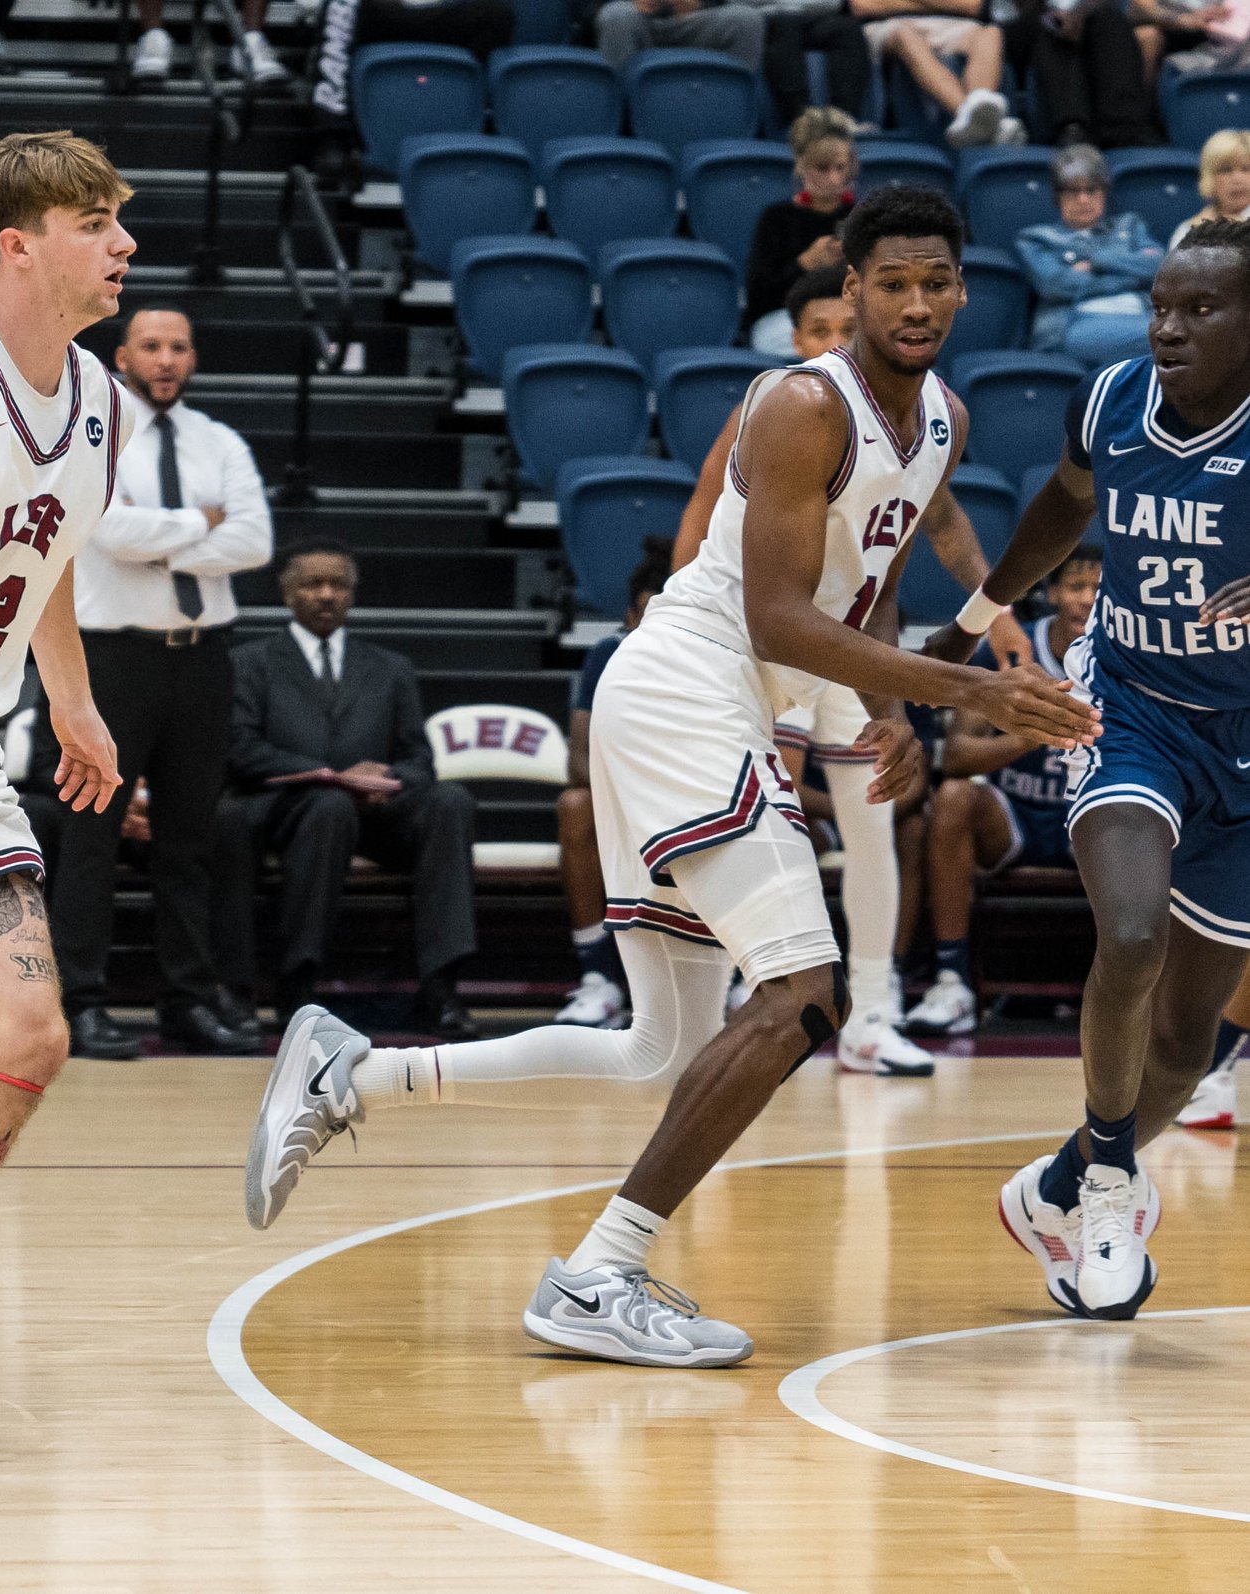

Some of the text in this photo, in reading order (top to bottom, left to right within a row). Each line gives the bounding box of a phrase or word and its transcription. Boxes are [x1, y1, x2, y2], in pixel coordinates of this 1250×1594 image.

[87, 422, 102, 440] LC
[931, 424, 948, 442] LC
[1208, 459, 1240, 473] SIAC
[1107, 487, 1225, 545] LANE
[1138, 555, 1207, 607] 23
[1101, 594, 1250, 657] COLLEG
[440, 717, 548, 756] LEE
[999, 767, 1065, 801] COLL
